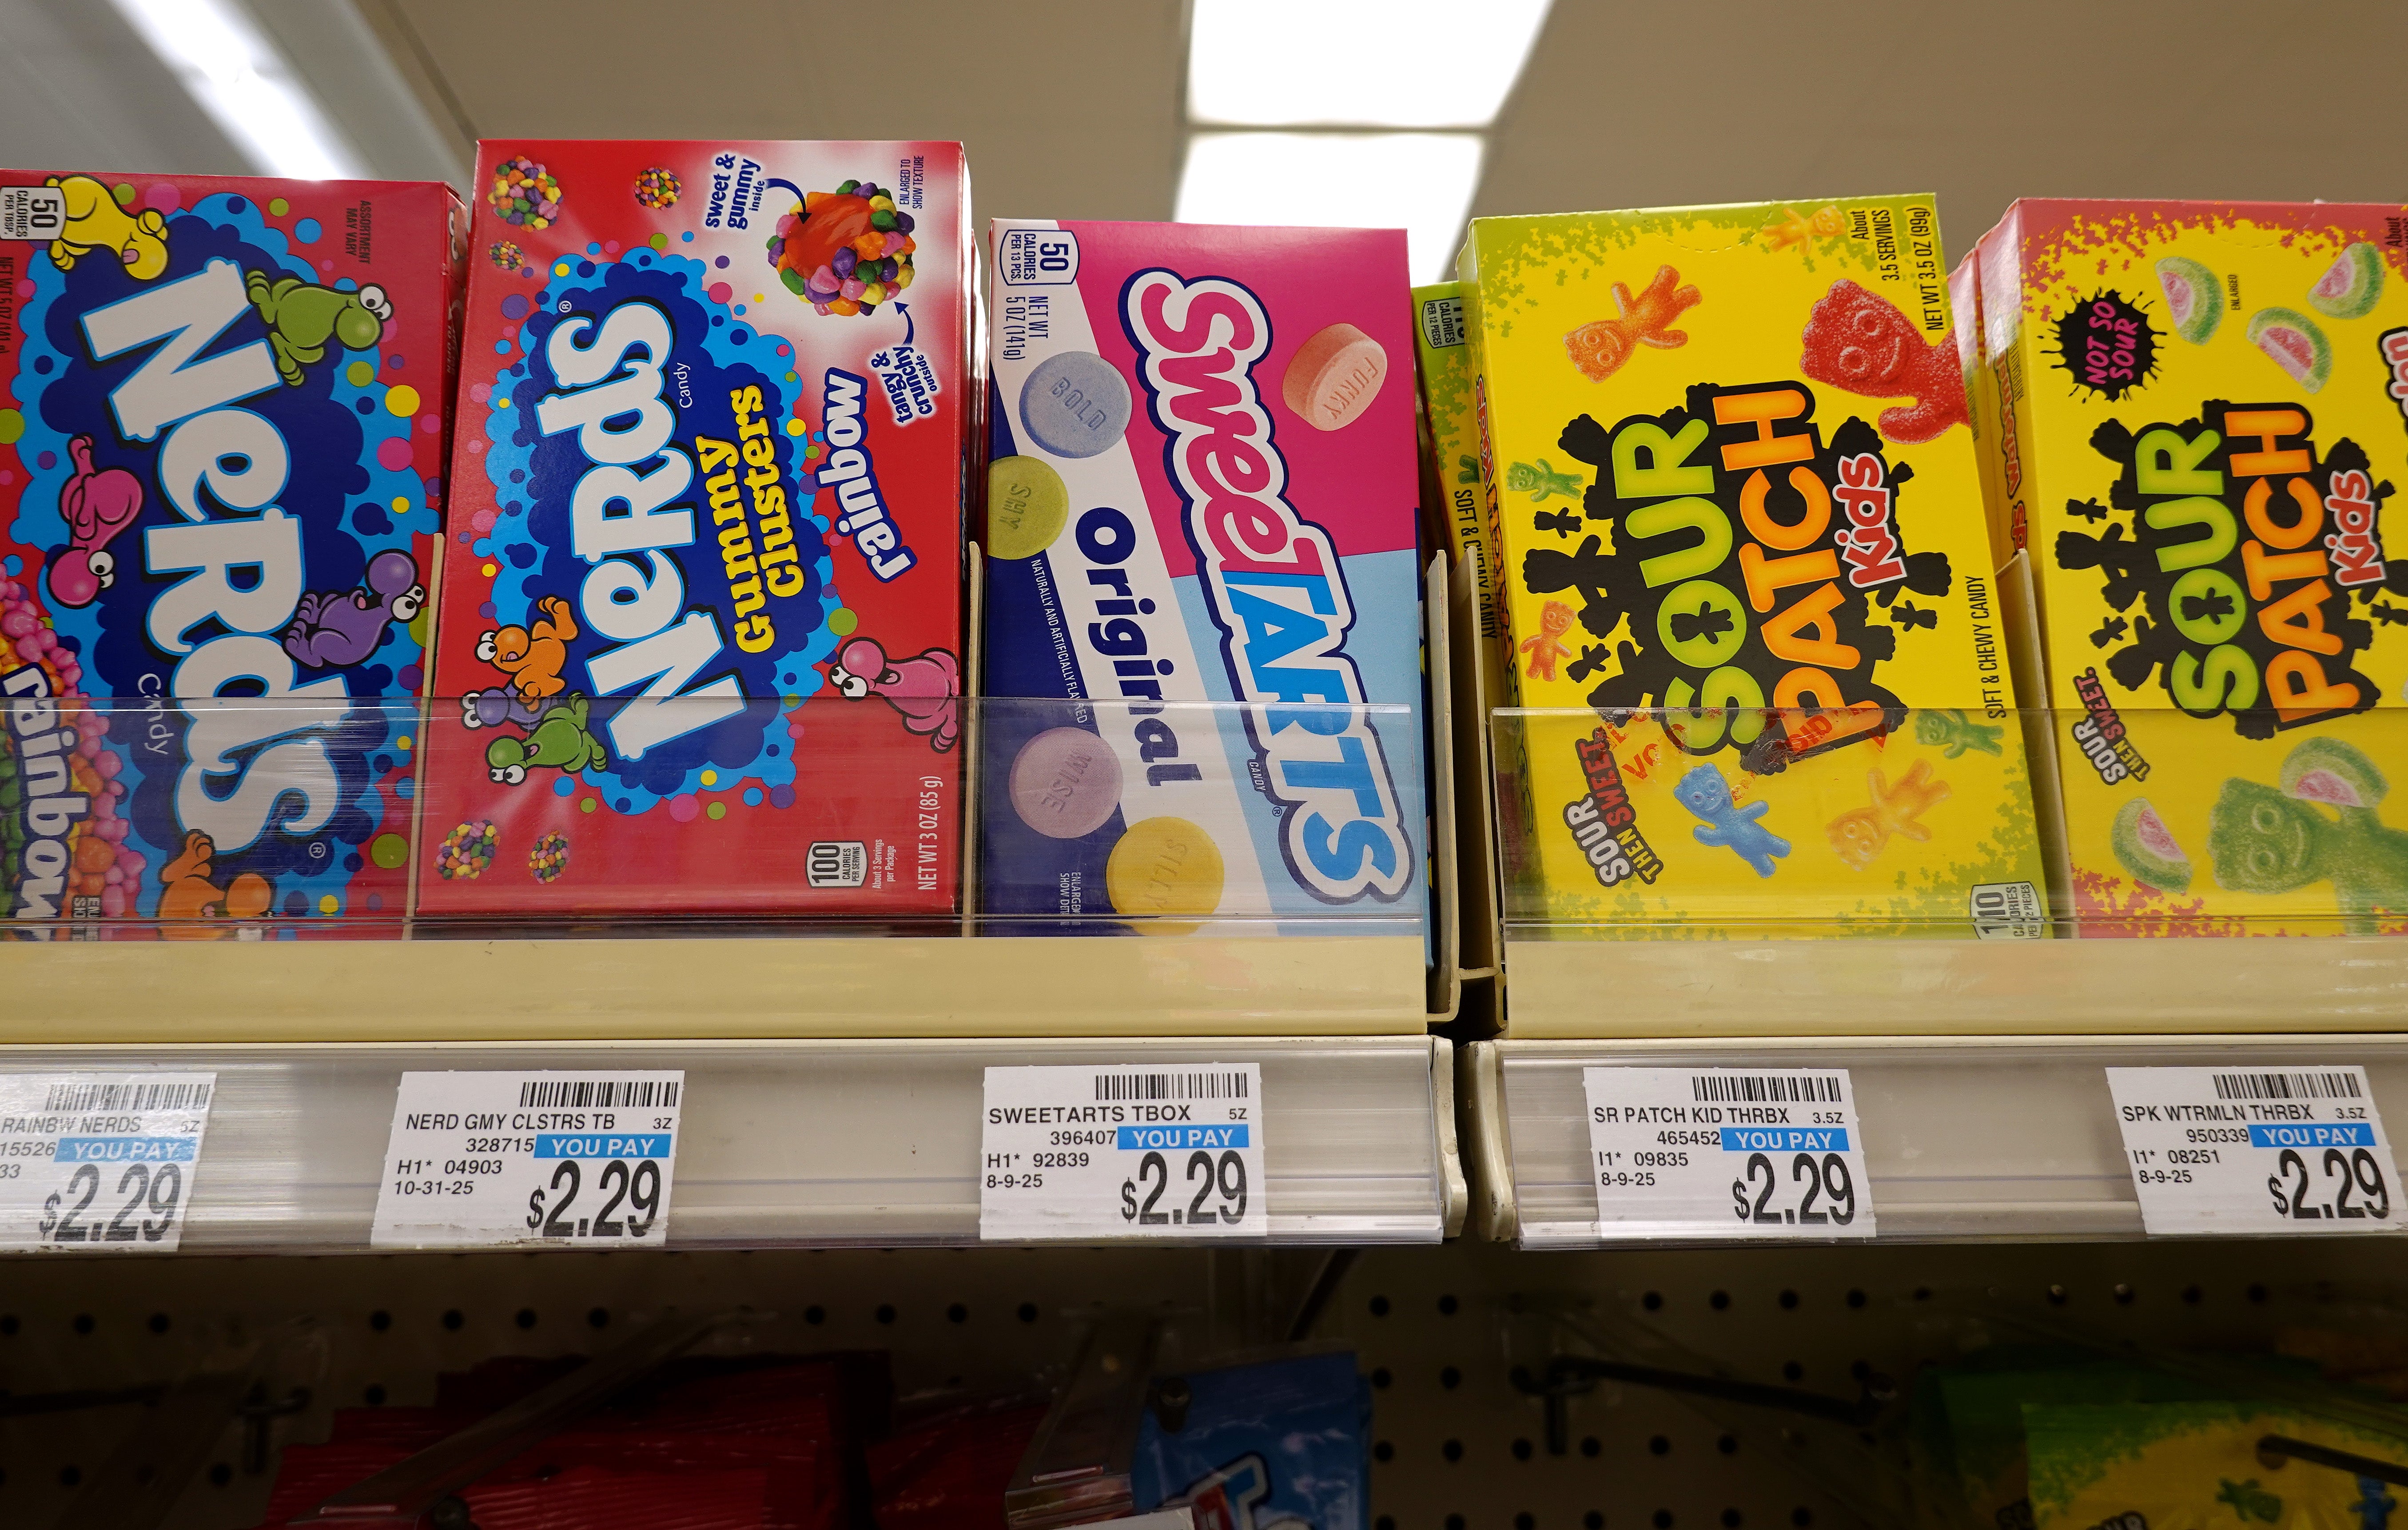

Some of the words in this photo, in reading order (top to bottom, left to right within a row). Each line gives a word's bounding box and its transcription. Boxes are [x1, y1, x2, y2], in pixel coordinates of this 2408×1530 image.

[716, 154, 736, 170] &
[900, 159, 911, 168] TO
[913, 155, 924, 186] TEXTURE
[705, 173, 731, 228] sweet
[727, 158, 761, 230] gummy
[748, 180, 765, 212] inside
[900, 169, 911, 205] ENLARGED
[912, 187, 923, 209] SHOW
[4, 195, 14, 210] PER
[16, 190, 28, 237] CALORIES
[31, 199, 59, 228] 50
[346, 207, 358, 229] MAY
[358, 200, 372, 265] ASSORTMENT
[1850, 210, 1870, 240] About
[1906, 207, 1931, 237] (99g)
[2382, 216, 2401, 247] About
[345, 232, 358, 256] VARY
[1011, 234, 1022, 249] PER
[1871, 209, 1897, 261] SERVINGS
[1913, 241, 1933, 256] OZ
[1011, 252, 1021, 261] 13
[1023, 233, 1036, 280] CALORIES
[1039, 242, 1069, 271] 50
[1916, 261, 1936, 279] 3.5
[1011, 263, 1022, 282] PCS.
[1880, 264, 1900, 281] 3.5
[1028, 296, 1048, 317] NET
[1919, 284, 1940, 305] WT
[2229, 274, 2241, 311] ENLARGED
[1006, 307, 1026, 322] OZ
[1427, 303, 1437, 315] PER
[1439, 302, 1456, 343] CALORIES
[1923, 308, 1944, 331] NET
[2088, 300, 2117, 329] SO
[1003, 325, 1026, 361] (141g)
[1028, 321, 1048, 338] WT
[1430, 325, 1442, 346] PIECES
[871, 350, 891, 368] &
[2085, 336, 2107, 384] NOT
[2109, 321, 2139, 381] SOUR
[673, 361, 693, 409] Candy
[892, 346, 933, 414] crunchy
[915, 354, 938, 392] outside
[881, 373, 913, 423] tangy
[1323, 357, 1378, 420] FUNKY
[1051, 377, 1106, 431] BOLD
[817, 370, 915, 581] rainbow
[731, 384, 804, 598] Clusters
[999, 484, 1031, 530] SHY
[1454, 490, 1477, 522] SOFT
[1835, 453, 1906, 587] Kids
[1461, 527, 1479, 537] &
[2325, 470, 2386, 586] Kids
[695, 435, 775, 654] Gummy
[1711, 388, 1885, 740] PATCH
[2135, 429, 2259, 712] SOUR
[2223, 409, 2360, 723] PATCH
[1031, 559, 1055, 607] NATURALLY
[1612, 420, 1768, 751] SOUR
[1965, 576, 1990, 619] CANDY
[1044, 608, 1060, 627] AND
[1050, 628, 1076, 681] ARTIFICIALLY
[1972, 624, 1998, 671] CHEWY
[1980, 675, 1999, 684] &
[138, 673, 174, 755] Candy
[1982, 688, 2006, 718] SOFT
[2076, 669, 2124, 740] SWEET.
[2074, 717, 2128, 783] SOUR
[2113, 740, 2149, 779] THEN
[919, 775, 943, 788] g)
[1249, 762, 1266, 791] CANDY
[3, 664, 91, 941] rainbow
[919, 791, 941, 811] (85
[919, 813, 938, 829] OZ
[872, 839, 884, 865] Servings
[918, 842, 938, 863] WT
[1567, 797, 1631, 883] SOUR
[1616, 827, 1660, 880] THEN
[812, 844, 840, 883] 100
[842, 848, 852, 880] CALORIES
[885, 845, 896, 870] Package
[872, 872, 882, 889] About
[887, 873, 896, 882] per
[918, 866, 937, 890] NET
[1060, 873, 1070, 898] SHOW
[2020, 884, 2034, 910] PIECES
[1, 1117, 75, 1133] RAINBW
[79, 1116, 143, 1133] NERDS
[179, 1120, 200, 1133] 5Z
[406, 1113, 459, 1130] NERD
[464, 1113, 507, 1130] GMY
[512, 1113, 586, 1130] CLSTRS
[592, 1113, 615, 1130] TB
[653, 1117, 673, 1129] 3Z
[989, 1106, 1125, 1125] SWEETARTS
[1131, 1105, 1191, 1121] TBOX
[1229, 1108, 1247, 1120] 5Z
[1594, 1107, 1618, 1124] SR
[1624, 1107, 1687, 1124] PATCH
[1692, 1107, 1723, 1123] KID
[1730, 1108, 1791, 1124] THRBX
[1812, 1112, 1844, 1124] 3.5Z
[2121, 1105, 2161, 1122] SPK
[2163, 1105, 2246, 1121] WTRMLN
[2249, 1104, 2315, 1121] THRBX
[2335, 1108, 2368, 1119] 3.5Z
[0, 1141, 56, 1156] 15526
[74, 1142, 124, 1160] YOU
[129, 1142, 181, 1159] PAY
[466, 1138, 535, 1152] 328715
[552, 1139, 601, 1156] YOU
[607, 1138, 655, 1156] PAY
[1050, 1130, 1117, 1145] 396407
[1133, 1130, 1181, 1148] YOU
[1188, 1129, 1234, 1147] PAY
[1657, 1131, 1722, 1146] 465452
[1735, 1131, 1783, 1149] YOU
[1790, 1131, 1833, 1149] PAY
[2186, 1129, 2249, 1143] 950339
[2262, 1128, 2311, 1145] YOU
[2314, 1128, 2358, 1145] PAY
[444, 1160, 503, 1175] 04903
[1033, 1152, 1090, 1168] 92839
[1633, 1152, 1688, 1167] 09835
[2167, 1149, 2221, 1164] 08251
[394, 1180, 474, 1196] 10-31-25
[987, 1174, 1043, 1188] 8-9-25
[1121, 1150, 1247, 1225] $2.29
[1601, 1172, 1656, 1187] 8-9-25
[1732, 1152, 1855, 1225] $2.29
[2139, 1170, 2192, 1184] 8-9-25
[2267, 1148, 2388, 1220] $2.29
[39, 1163, 181, 1242] $2.29
[526, 1159, 661, 1238] $2.29
